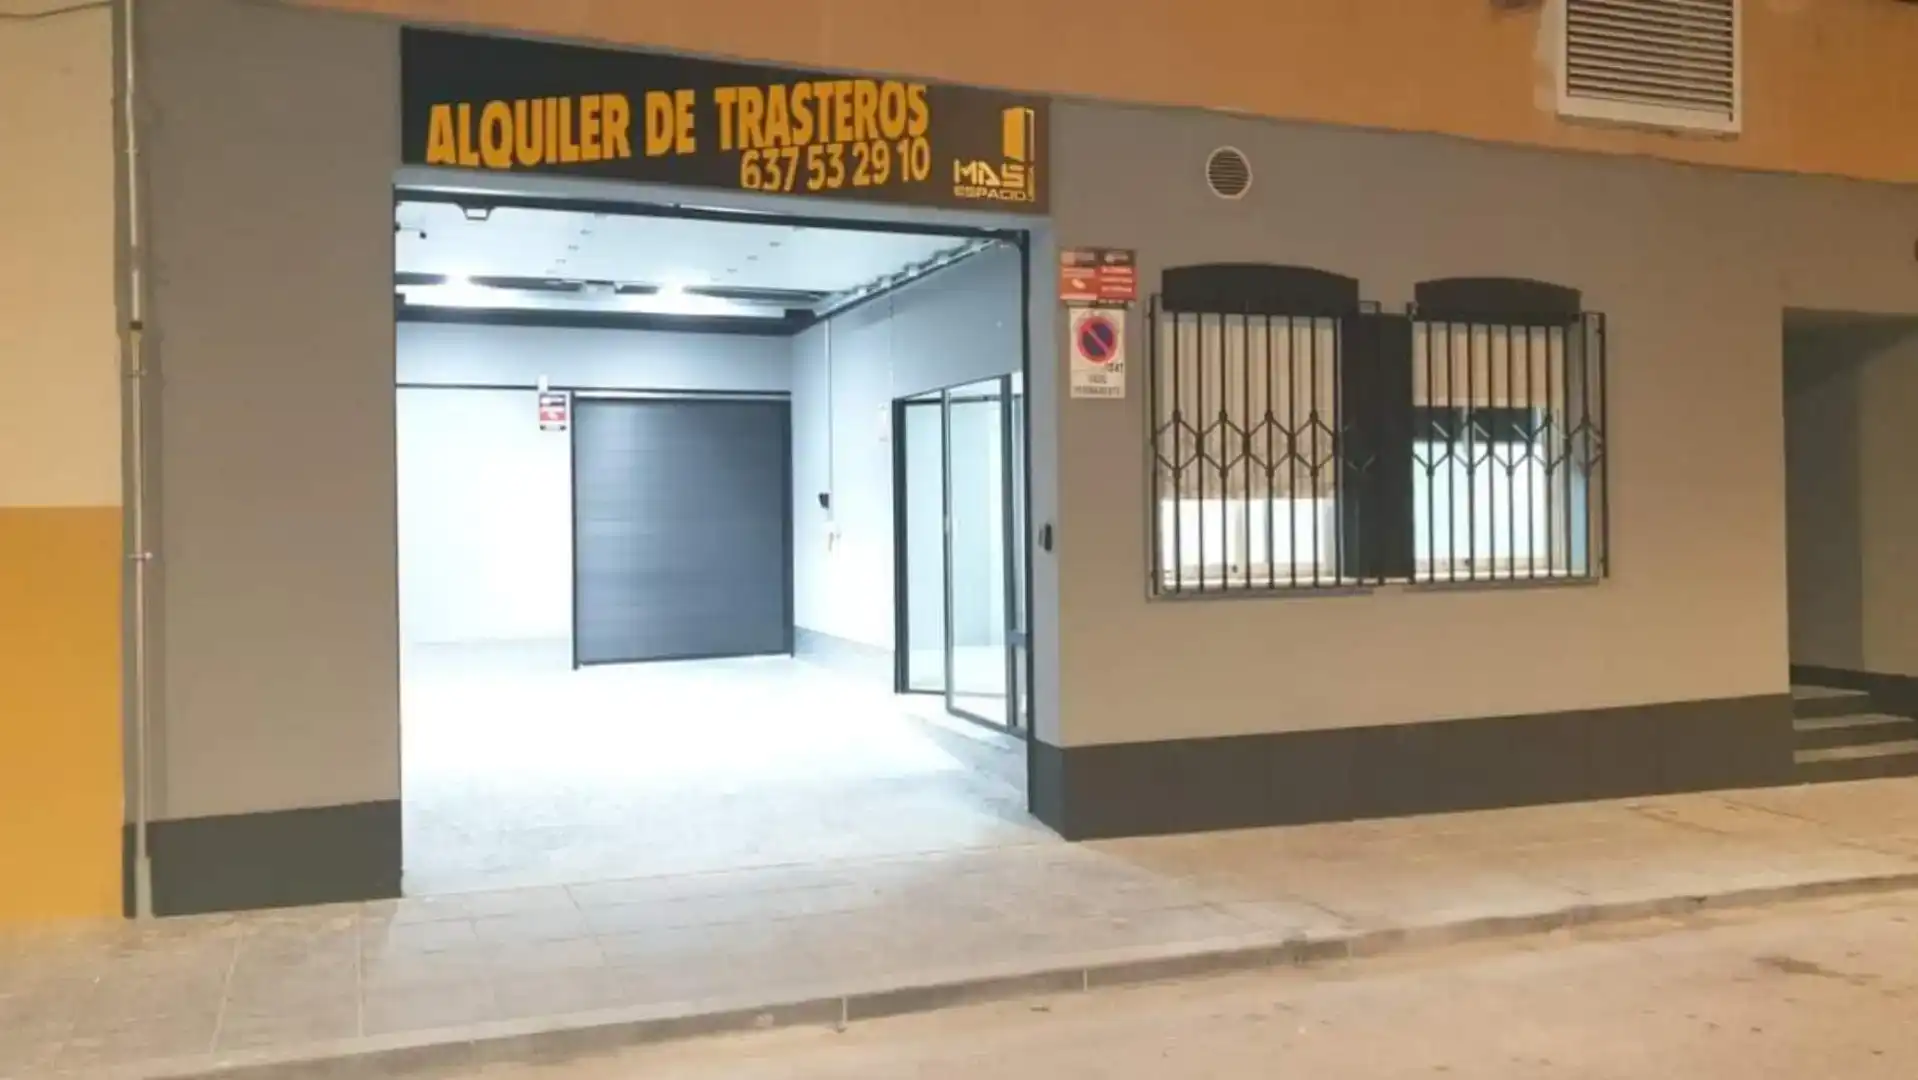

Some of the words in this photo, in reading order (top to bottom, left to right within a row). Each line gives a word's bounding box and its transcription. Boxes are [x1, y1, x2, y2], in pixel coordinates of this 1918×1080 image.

[427, 93, 630, 168] ALQUILER
[646, 89, 695, 155] DE
[714, 80, 929, 149] TRASTEROS
[741, 147, 799, 191] 637
[806, 144, 844, 190] 53
[852, 142, 890, 186] 29
[899, 137, 930, 180] 10
[954, 159, 1024, 188] MAS
[954, 186, 1026, 201] ESPACIO
